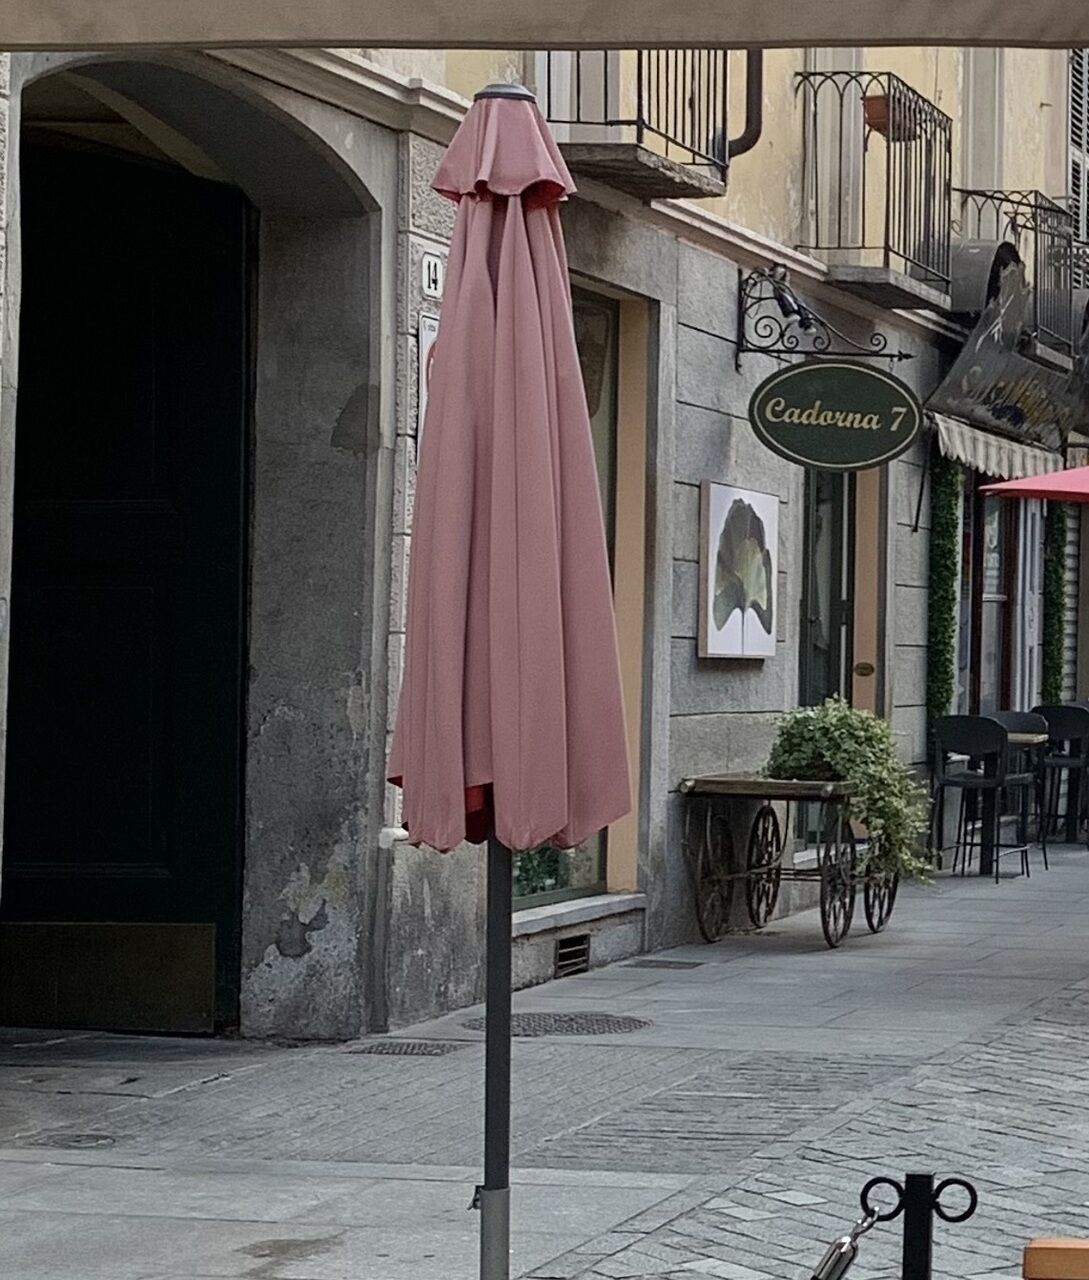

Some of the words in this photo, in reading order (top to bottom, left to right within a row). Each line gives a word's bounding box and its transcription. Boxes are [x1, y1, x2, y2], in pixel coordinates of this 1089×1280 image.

[427, 261, 438, 291] 14
[765, 397, 882, 431] Cadorna
[889, 406, 908, 432] 7
